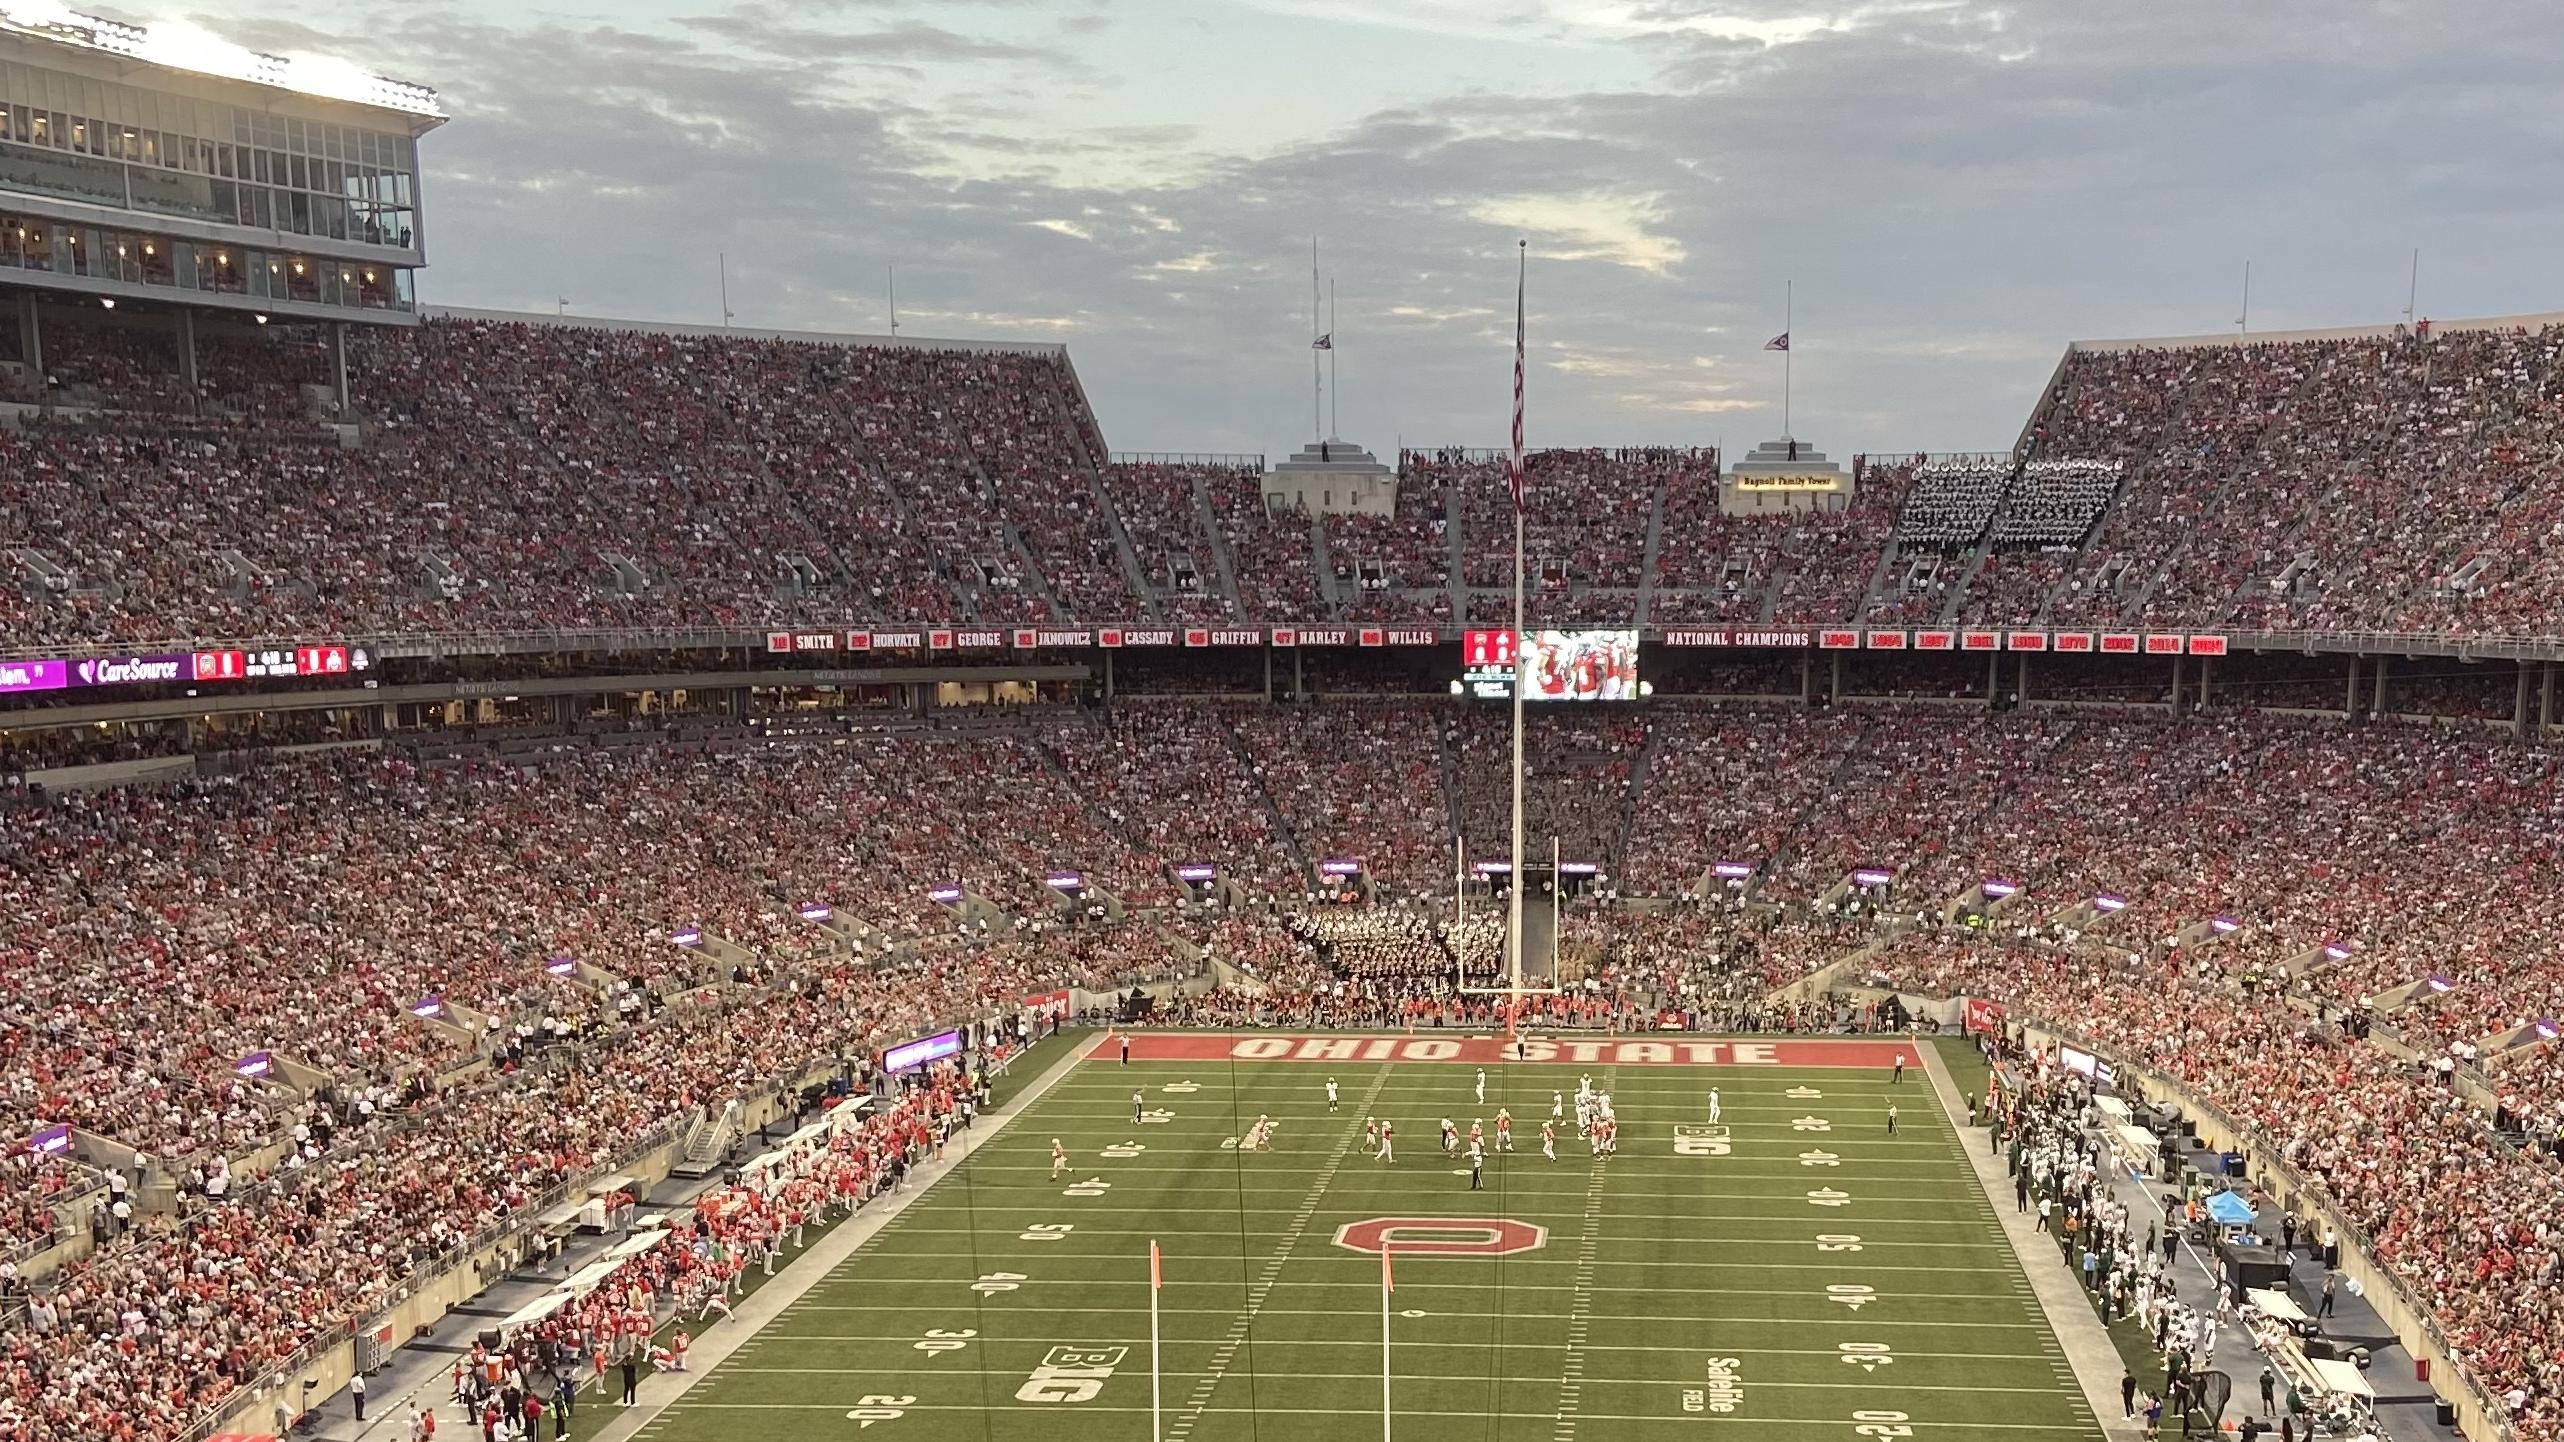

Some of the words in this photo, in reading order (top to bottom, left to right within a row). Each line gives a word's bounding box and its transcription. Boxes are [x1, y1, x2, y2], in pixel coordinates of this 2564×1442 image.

[1778, 477, 1805, 487] Family
[1808, 477, 1831, 485] Tower
[796, 634, 834, 649] SMITH
[873, 633, 920, 647] HORVATH
[958, 632, 1000, 646] GEORGE
[1125, 632, 1173, 645] CASSADY
[1212, 631, 1259, 645] GRIFFIN
[1299, 631, 1346, 644] HARLEY
[1388, 631, 1433, 644] WILLIS
[1666, 632, 1728, 646] NATIONAL
[1735, 632, 1809, 646] CHAMPIONS
[97, 657, 179, 683] CareSource
[1230, 1038, 1463, 1060] OHIO
[1500, 1040, 1780, 1064] STATE
[1100, 1145, 1146, 1157] 30
[1799, 1153, 1840, 1166] 30
[1019, 1224, 1074, 1240] 50
[1815, 1234, 1863, 1251] 50
[970, 1272, 1028, 1291] 40
[1825, 1284, 1877, 1304] 40
[913, 1329, 977, 1350] 30
[1838, 1343, 1893, 1364] 30
[1707, 1357, 1744, 1412] Safelite
[846, 1395, 917, 1419] 20
[1852, 1410, 1913, 1436] 20
